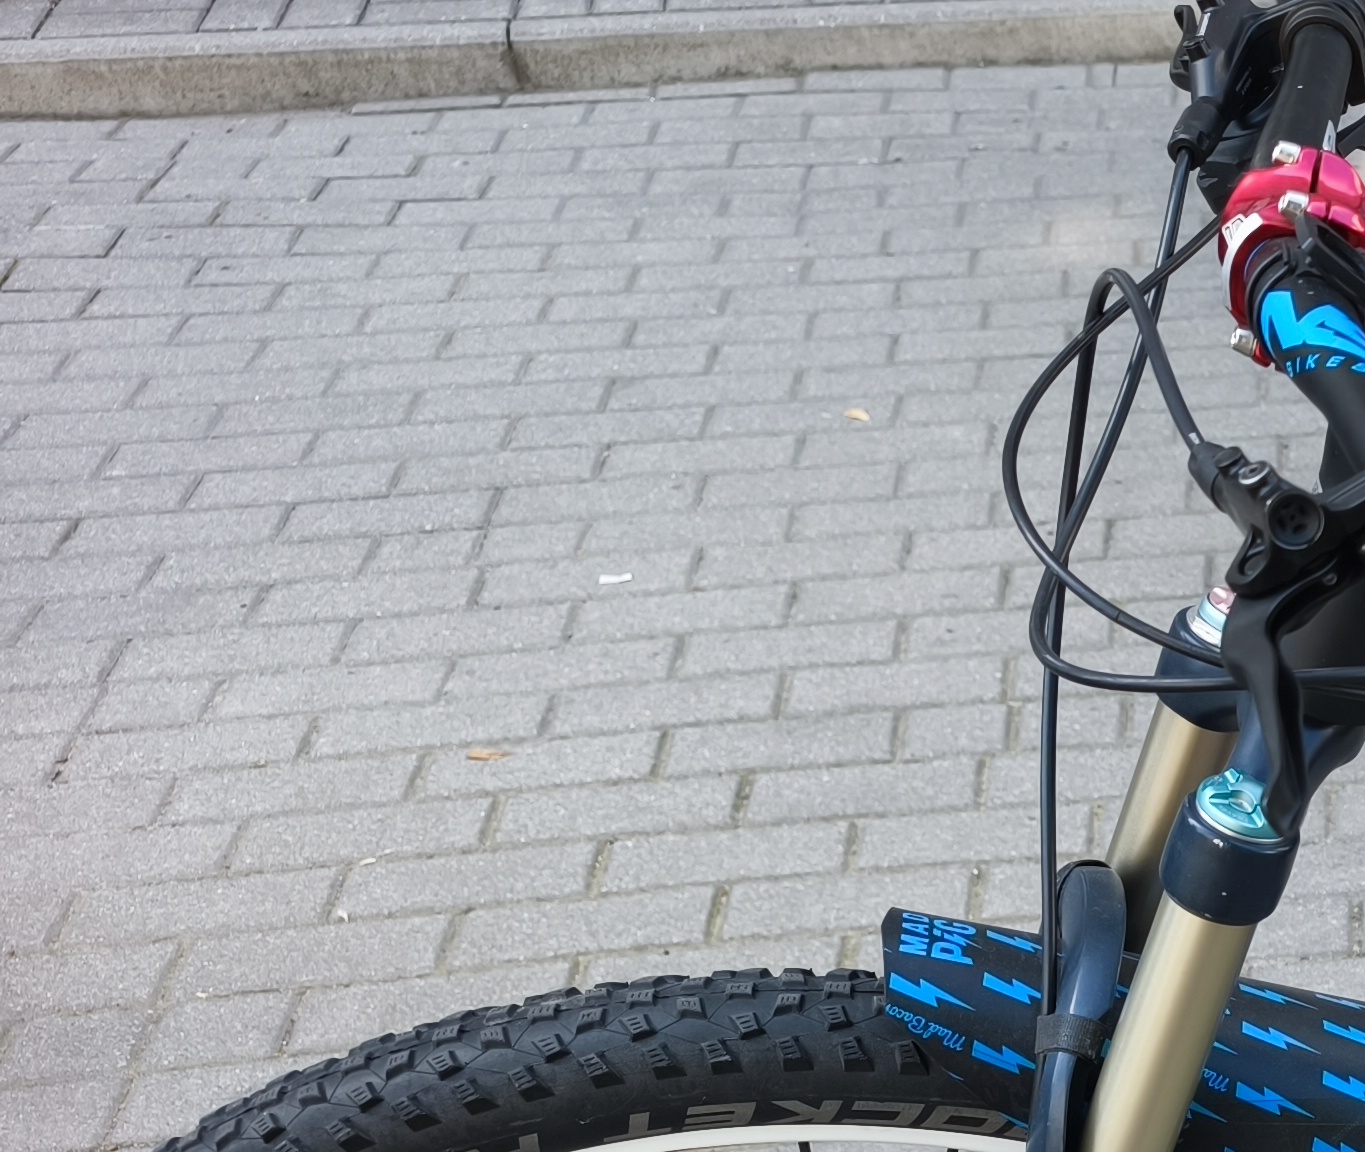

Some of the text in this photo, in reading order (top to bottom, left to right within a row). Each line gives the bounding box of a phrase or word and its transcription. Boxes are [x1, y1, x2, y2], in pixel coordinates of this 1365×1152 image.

[899, 912, 930, 956] MAD
[923, 1022, 966, 1051] Mad
[603, 1099, 1028, 1143] OCKET
